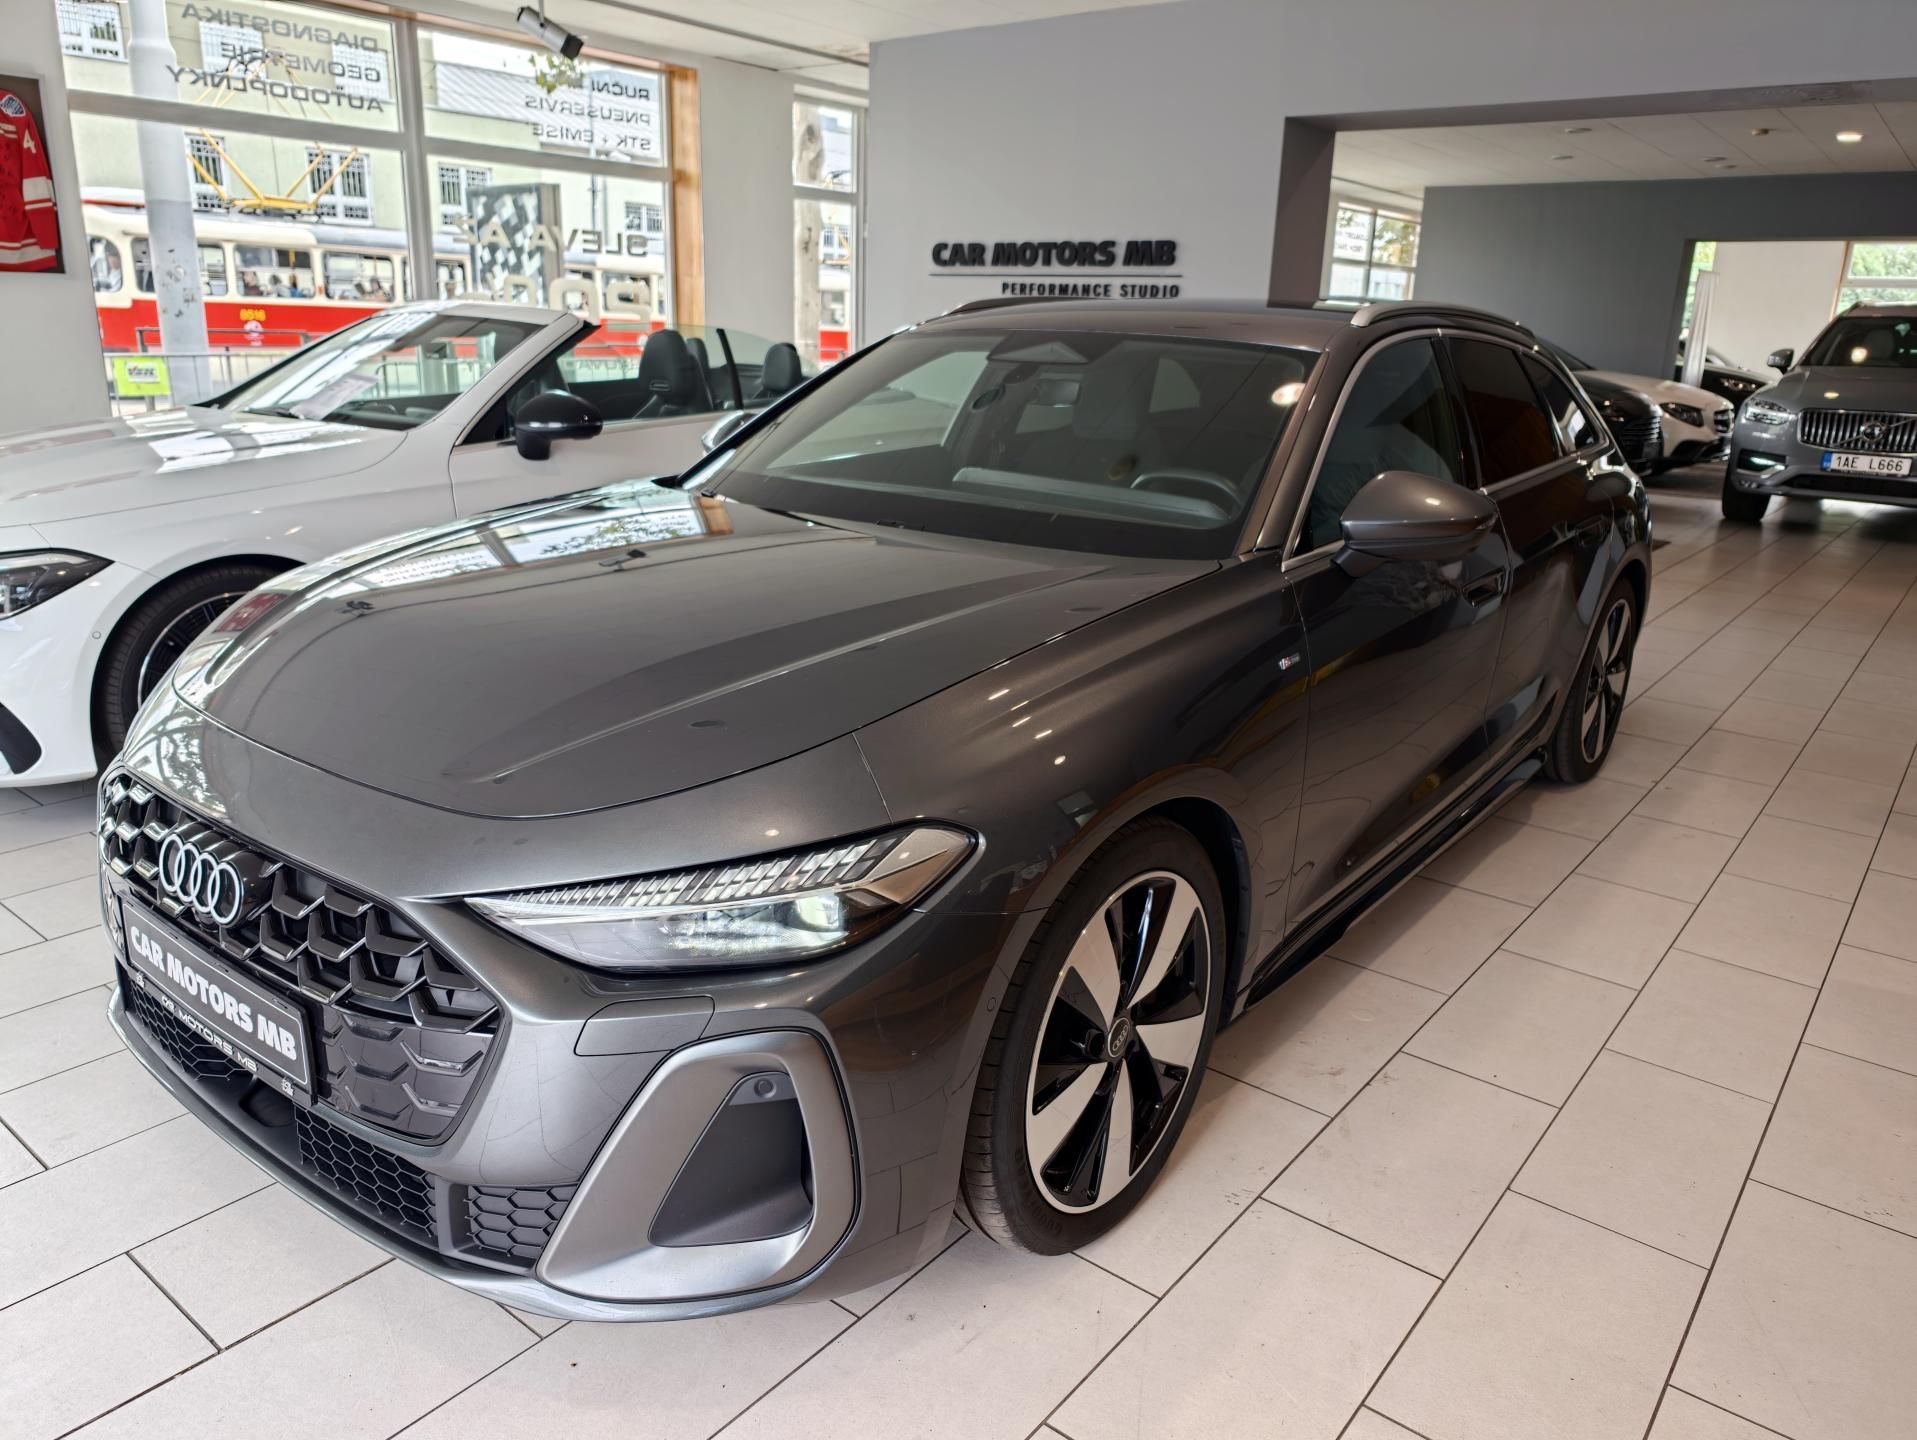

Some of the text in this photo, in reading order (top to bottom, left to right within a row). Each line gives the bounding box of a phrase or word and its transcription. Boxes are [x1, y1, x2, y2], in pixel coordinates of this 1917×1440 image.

[932, 240, 1177, 267] CAR MOTORS MB
[1002, 282, 1180, 298] PERFORMANCE STUDIO
[1836, 455, 1904, 472] 1AE L666
[130, 926, 297, 1061] CAR MOTORS MB
[178, 1010, 234, 1056] MOTORS
[237, 1052, 258, 1072] MB
